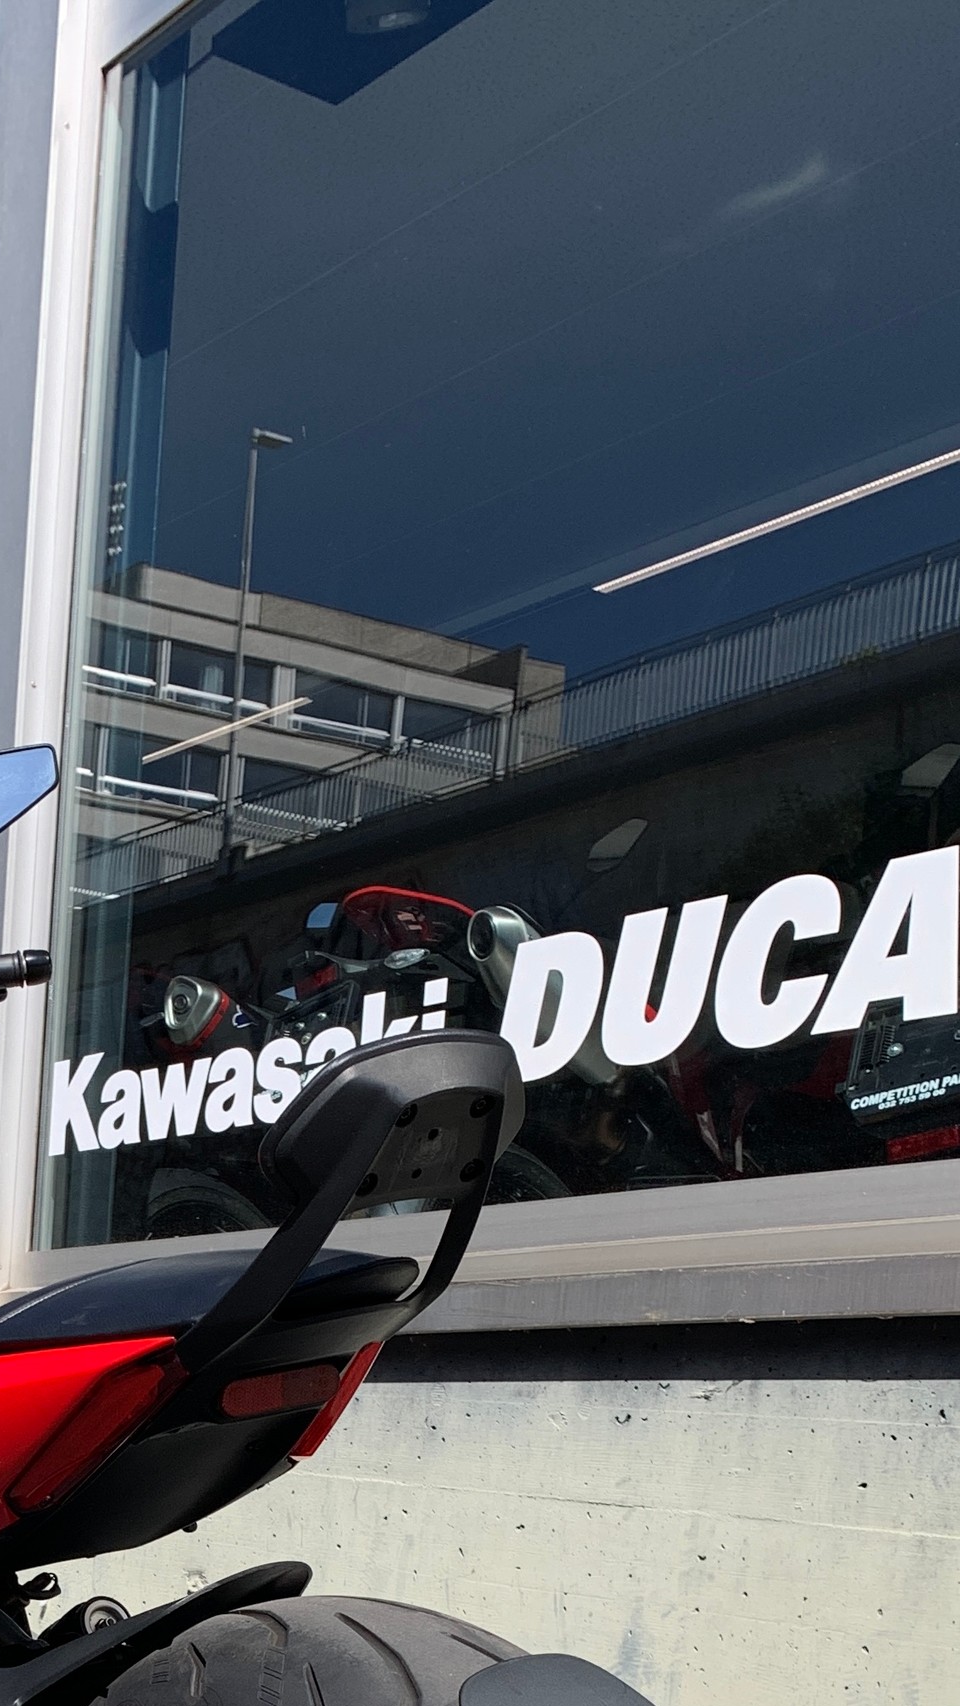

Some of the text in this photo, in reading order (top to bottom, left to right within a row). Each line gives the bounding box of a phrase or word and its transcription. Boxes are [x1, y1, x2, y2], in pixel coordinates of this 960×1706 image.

[500, 845, 960, 1082] DUCA
[850, 1073, 960, 1110] COMPETITION PA
